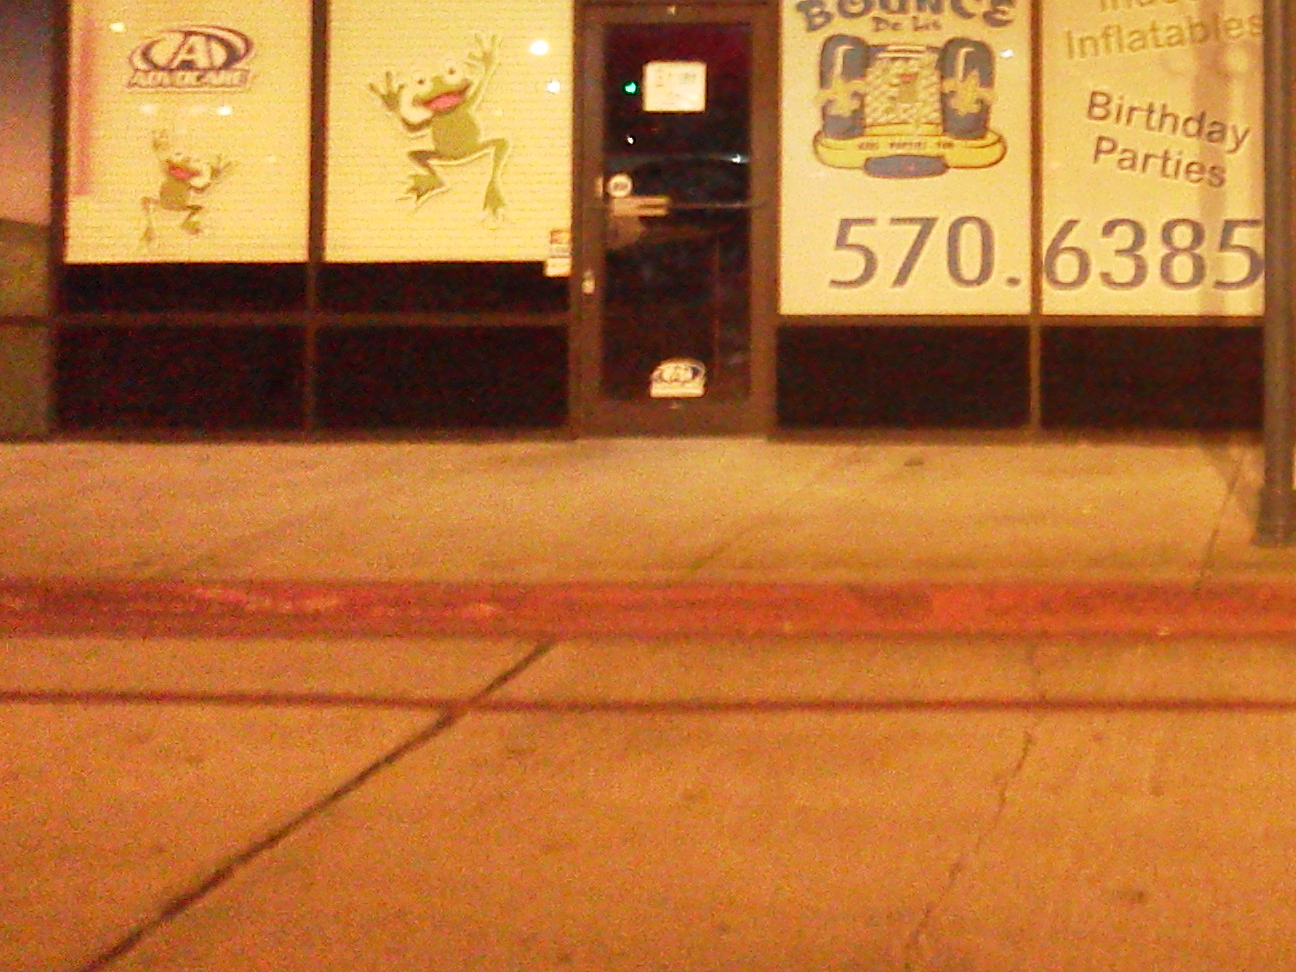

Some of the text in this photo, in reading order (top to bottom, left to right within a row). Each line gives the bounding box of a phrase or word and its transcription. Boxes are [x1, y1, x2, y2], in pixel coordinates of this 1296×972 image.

[1065, 12, 1265, 60] Inflatables
[1087, 89, 1251, 155] Birthday
[1092, 134, 1228, 189] Parties
[1043, 217, 1266, 292] 6385
